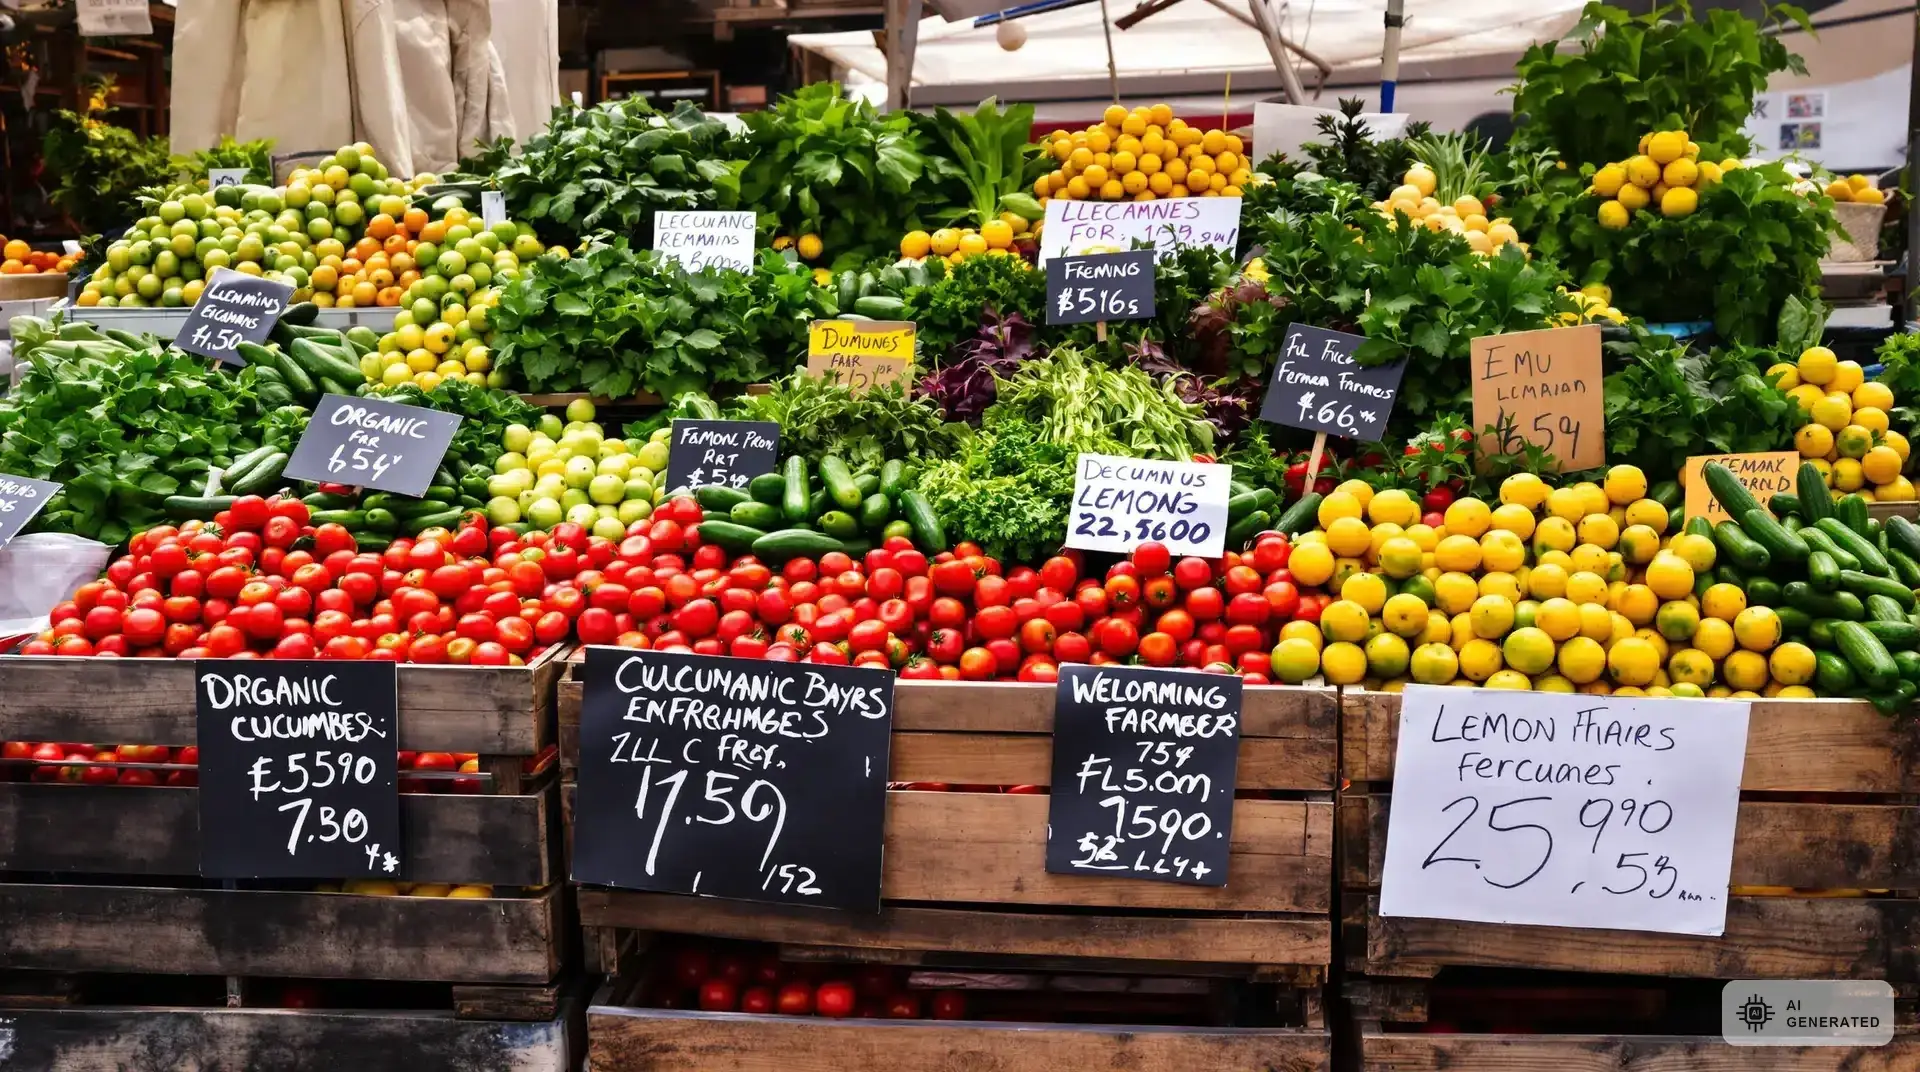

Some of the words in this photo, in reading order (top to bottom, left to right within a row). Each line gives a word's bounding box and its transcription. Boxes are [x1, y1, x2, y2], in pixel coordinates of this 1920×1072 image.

[1481, 345, 1552, 380] EMU
[330, 404, 428, 439] ORGANIC
[1431, 704, 1556, 743] LEMON
